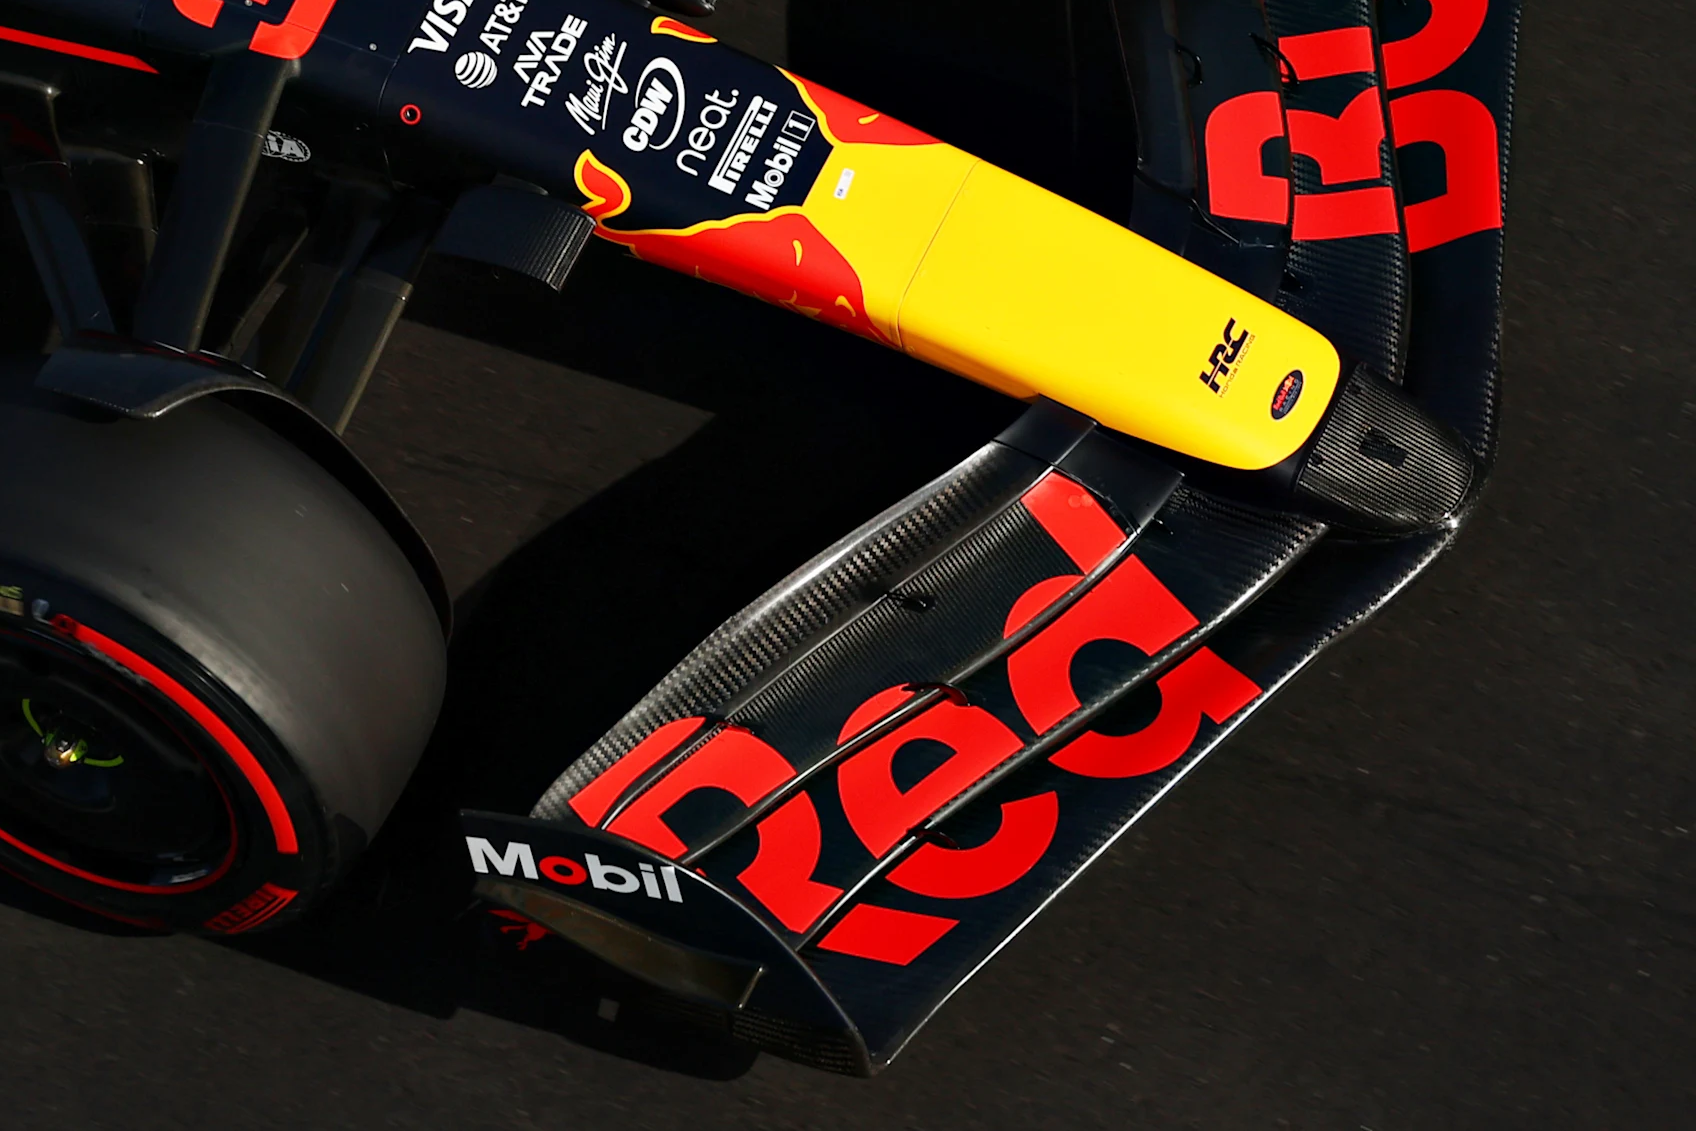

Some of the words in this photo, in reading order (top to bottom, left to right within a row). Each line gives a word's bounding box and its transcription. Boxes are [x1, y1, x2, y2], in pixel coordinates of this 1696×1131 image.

[512, 30, 556, 85] AVA
[520, 13, 589, 108] TRADE
[583, 32, 630, 131] Jim
[565, 78, 605, 136] Maui
[622, 76, 674, 153] CDW
[676, 88, 740, 178] neat.
[707, 94, 779, 195] PIRELLI
[744, 135, 803, 211] Mobil
[1199, 317, 1249, 394] HRC
[567, 469, 1263, 967] Red
[465, 835, 684, 904] Mobil
